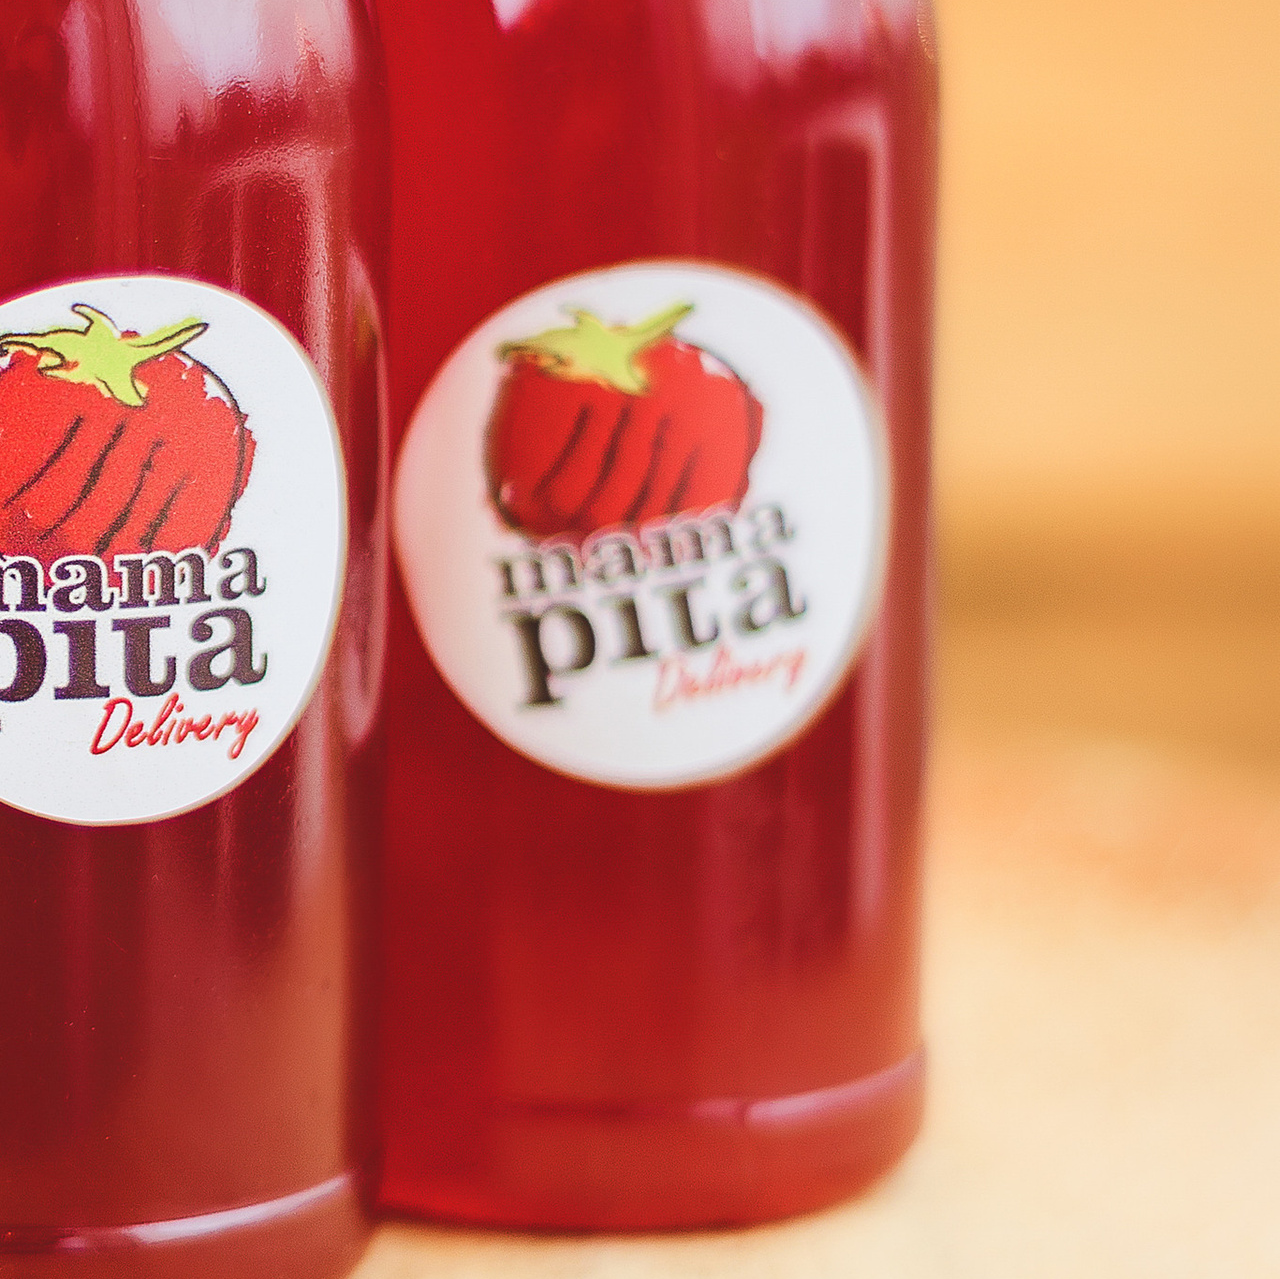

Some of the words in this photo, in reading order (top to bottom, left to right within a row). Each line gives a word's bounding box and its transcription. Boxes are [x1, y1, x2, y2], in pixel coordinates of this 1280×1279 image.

[500, 503, 794, 597] mama
[505, 555, 807, 710] pita
[90, 691, 260, 760] Delivery
